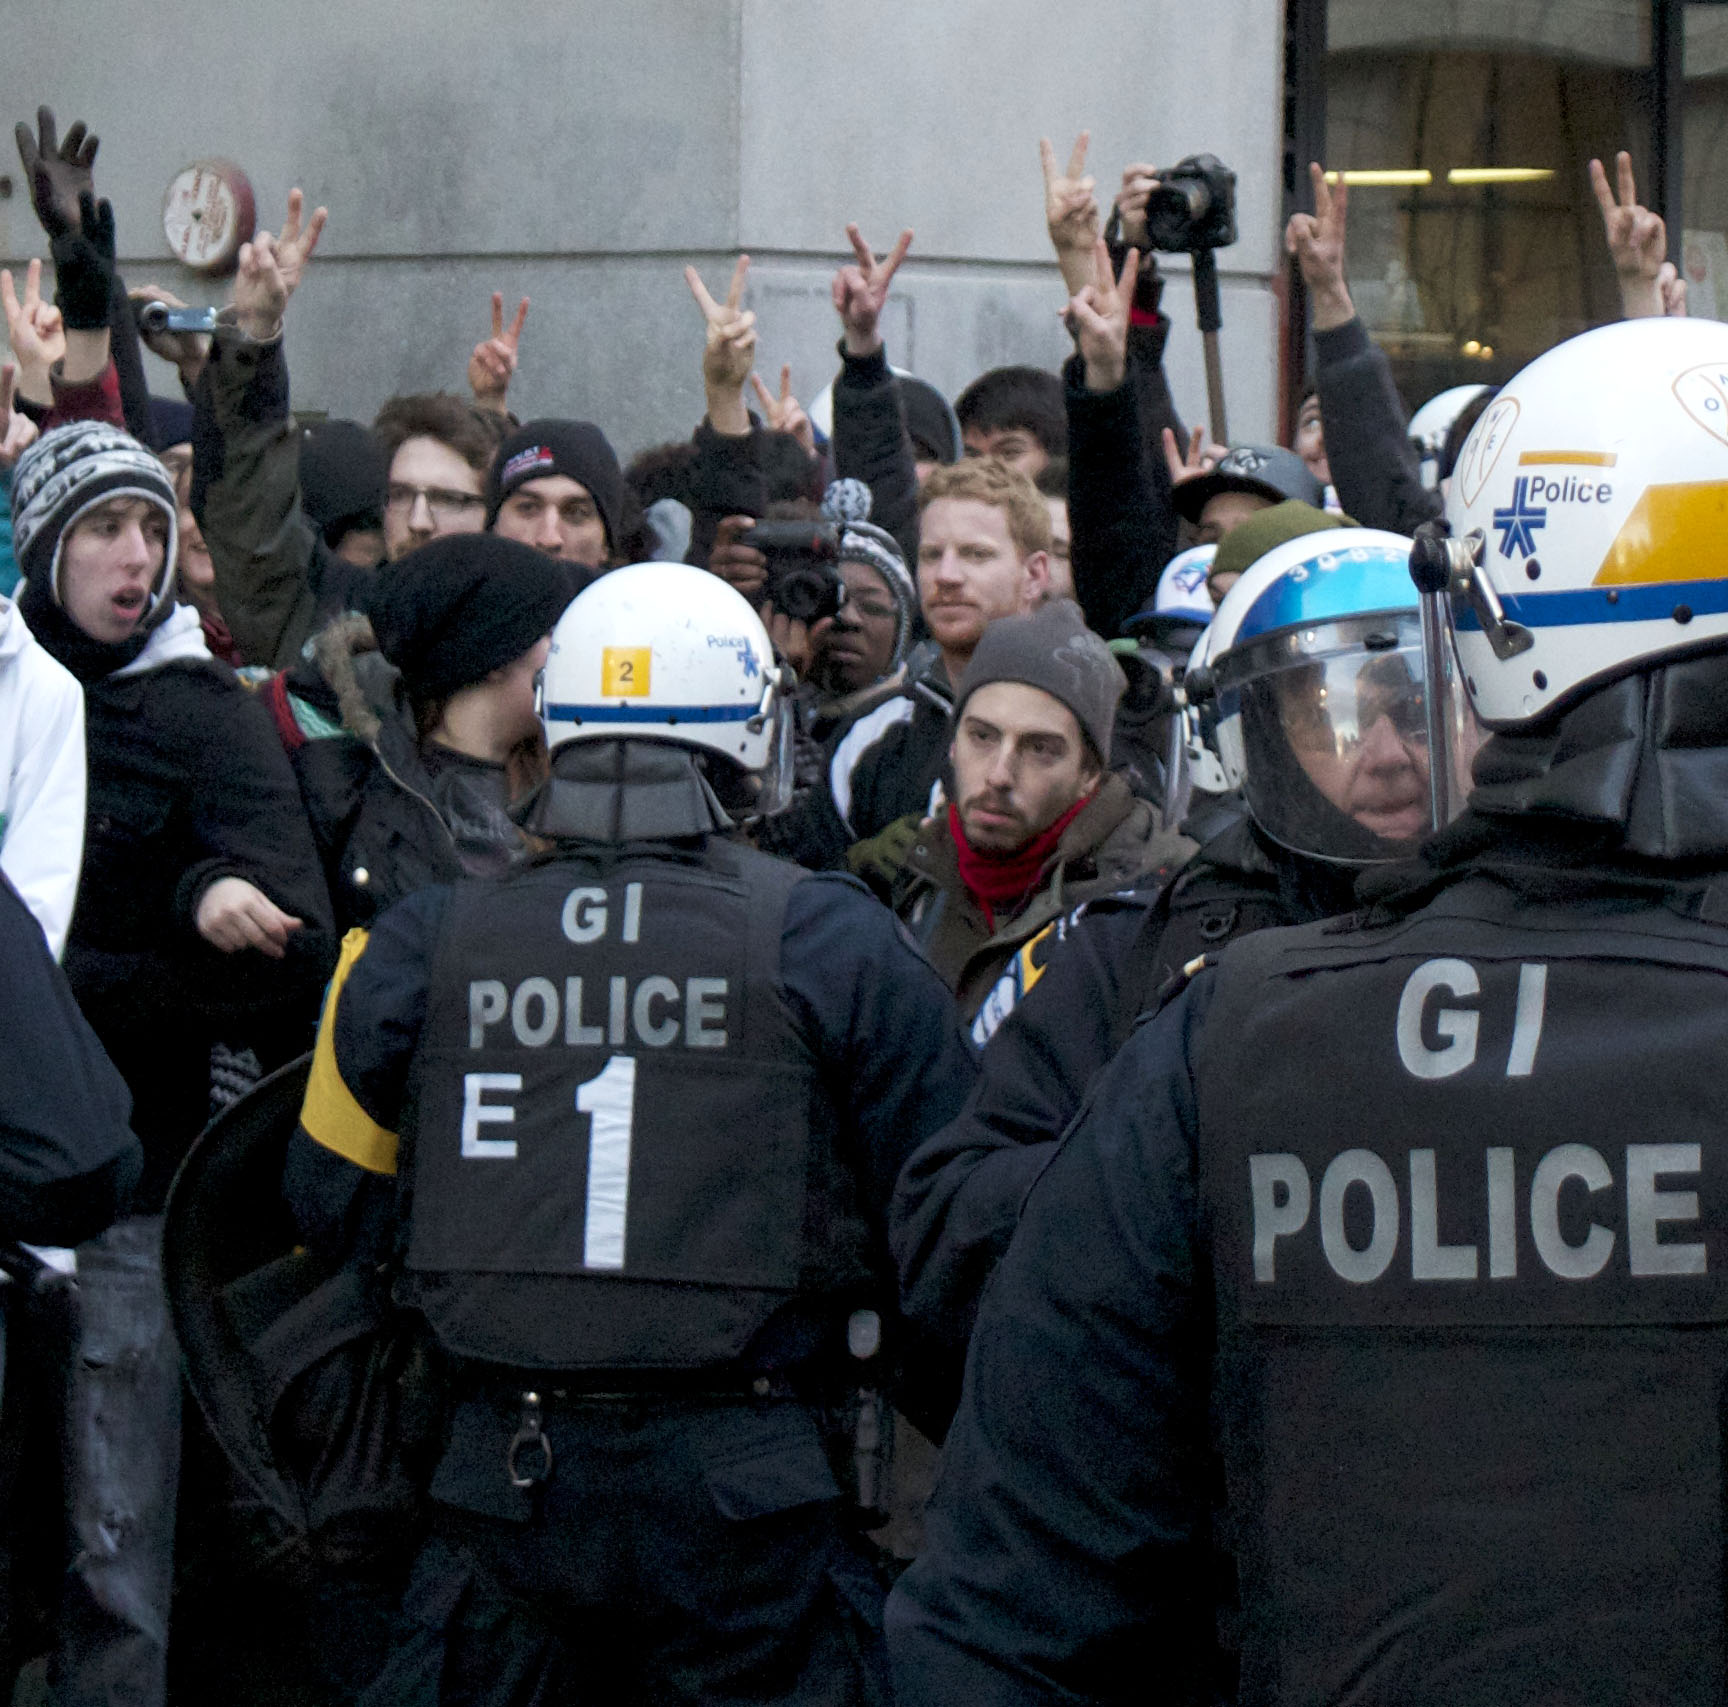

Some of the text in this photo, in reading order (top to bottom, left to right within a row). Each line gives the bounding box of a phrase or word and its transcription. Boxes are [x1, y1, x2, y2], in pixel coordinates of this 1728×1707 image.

[1529, 475, 1613, 503] Police
[619, 661, 634, 682] 2
[561, 882, 643, 943] GI
[469, 975, 729, 1050] POLICE
[1396, 958, 1548, 1080] GI
[1249, 1143, 1708, 1285] POLICE
